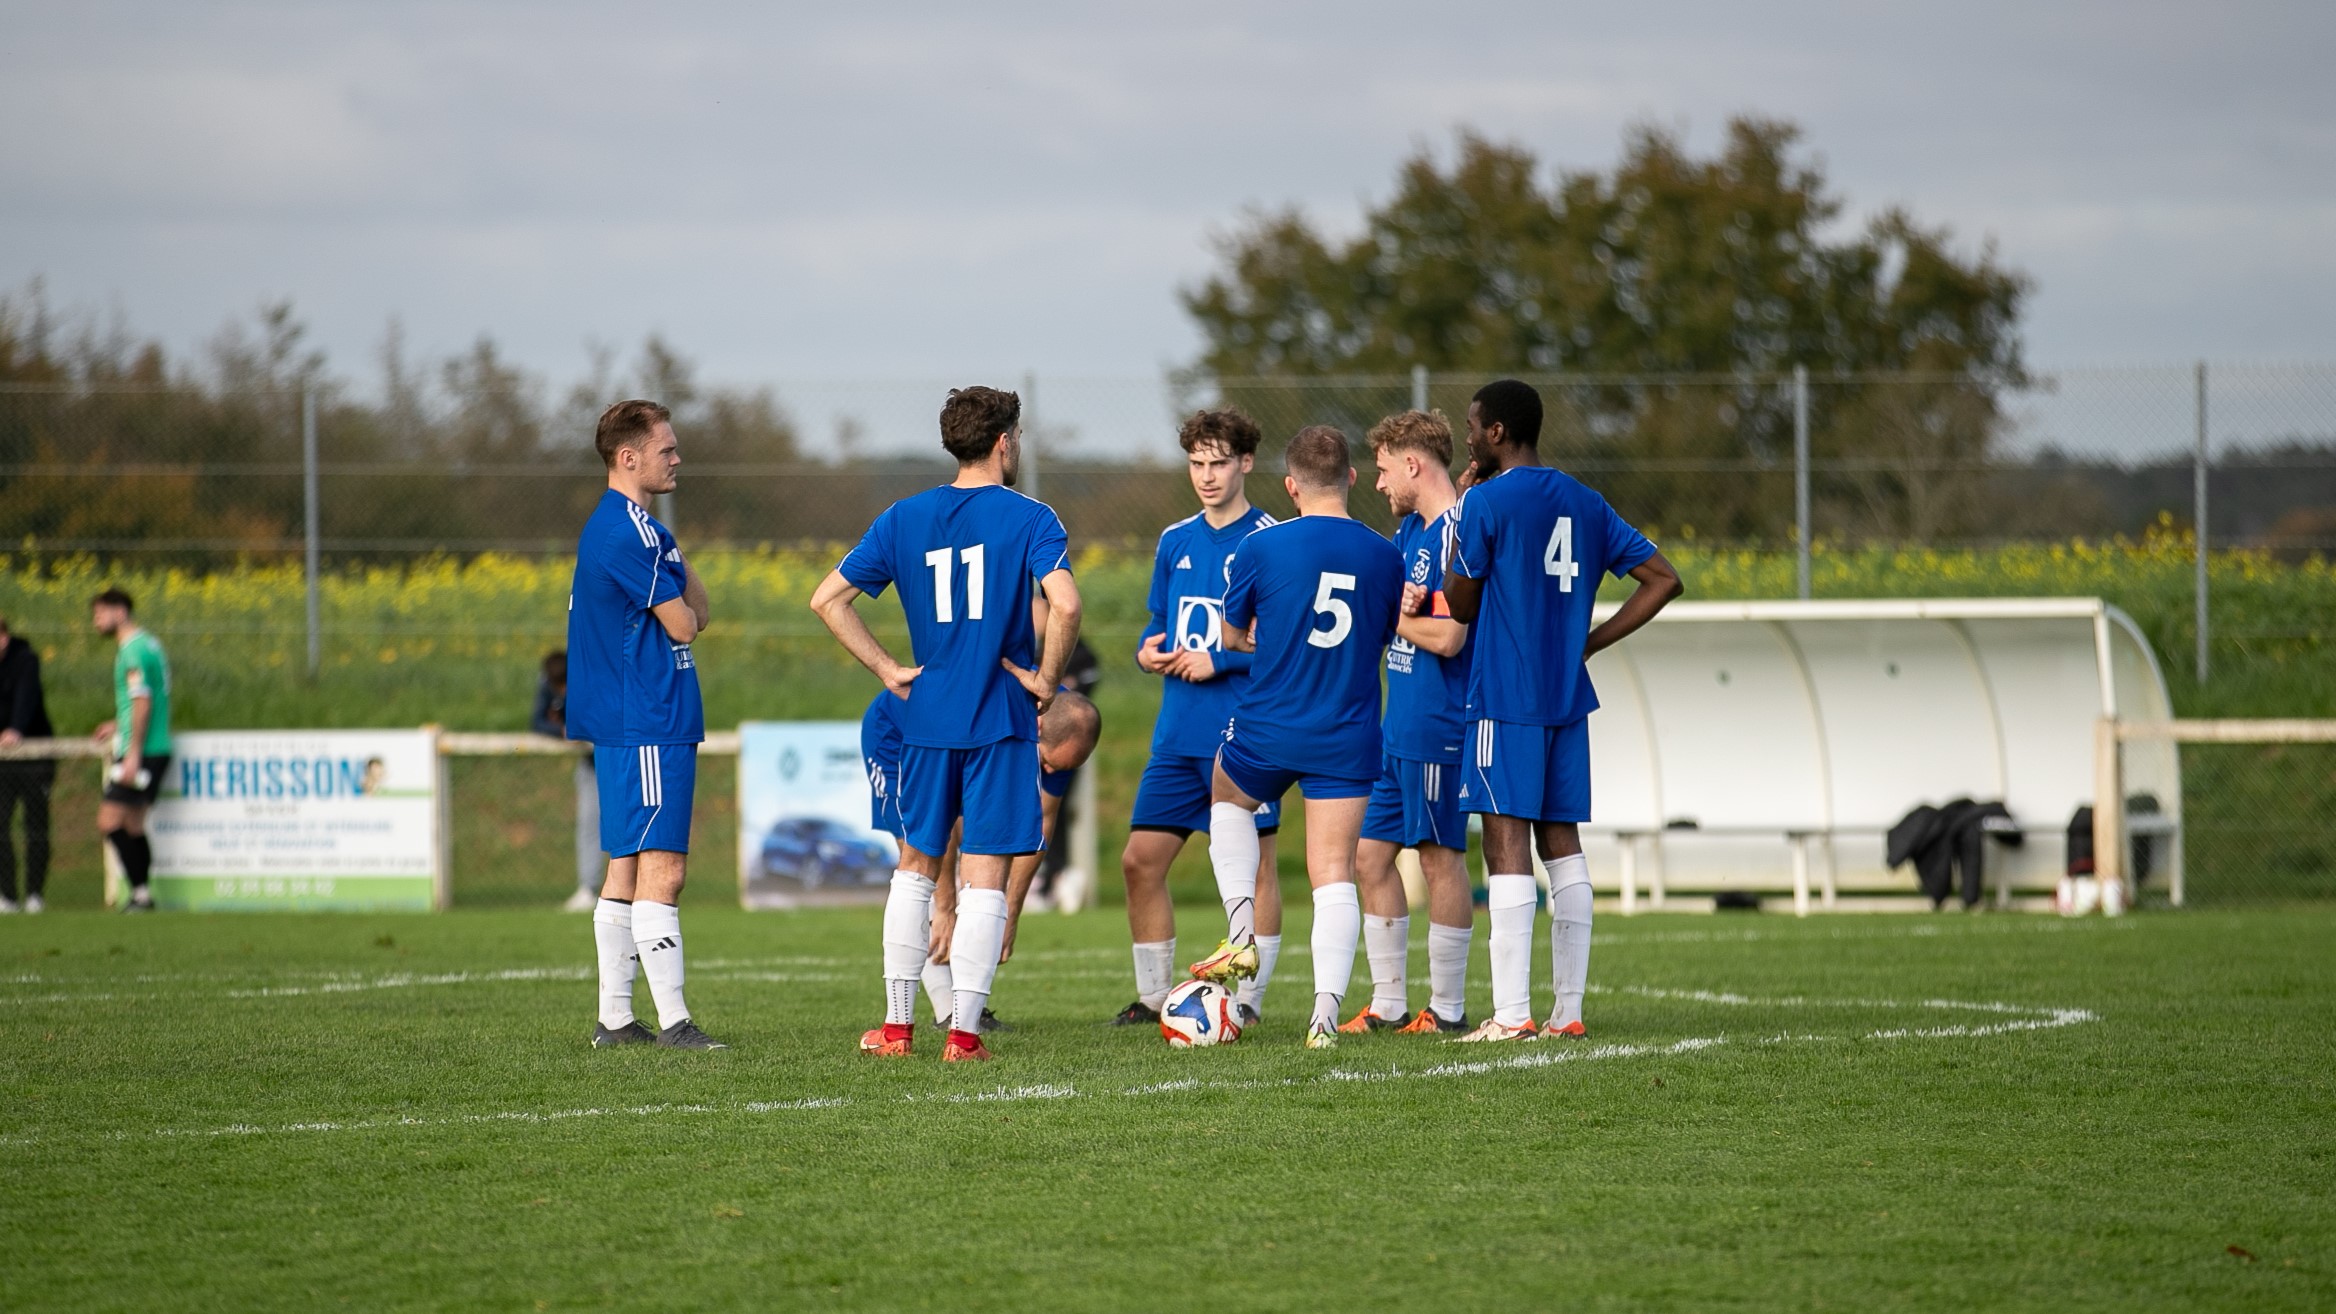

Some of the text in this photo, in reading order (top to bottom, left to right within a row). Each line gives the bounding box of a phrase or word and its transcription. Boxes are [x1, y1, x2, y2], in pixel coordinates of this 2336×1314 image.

[926, 544, 984, 622] 11
[1544, 517, 1578, 592] 4
[1178, 598, 1221, 652] Q
[1307, 572, 1357, 648] 5
[181, 757, 363, 797] HERISSON
